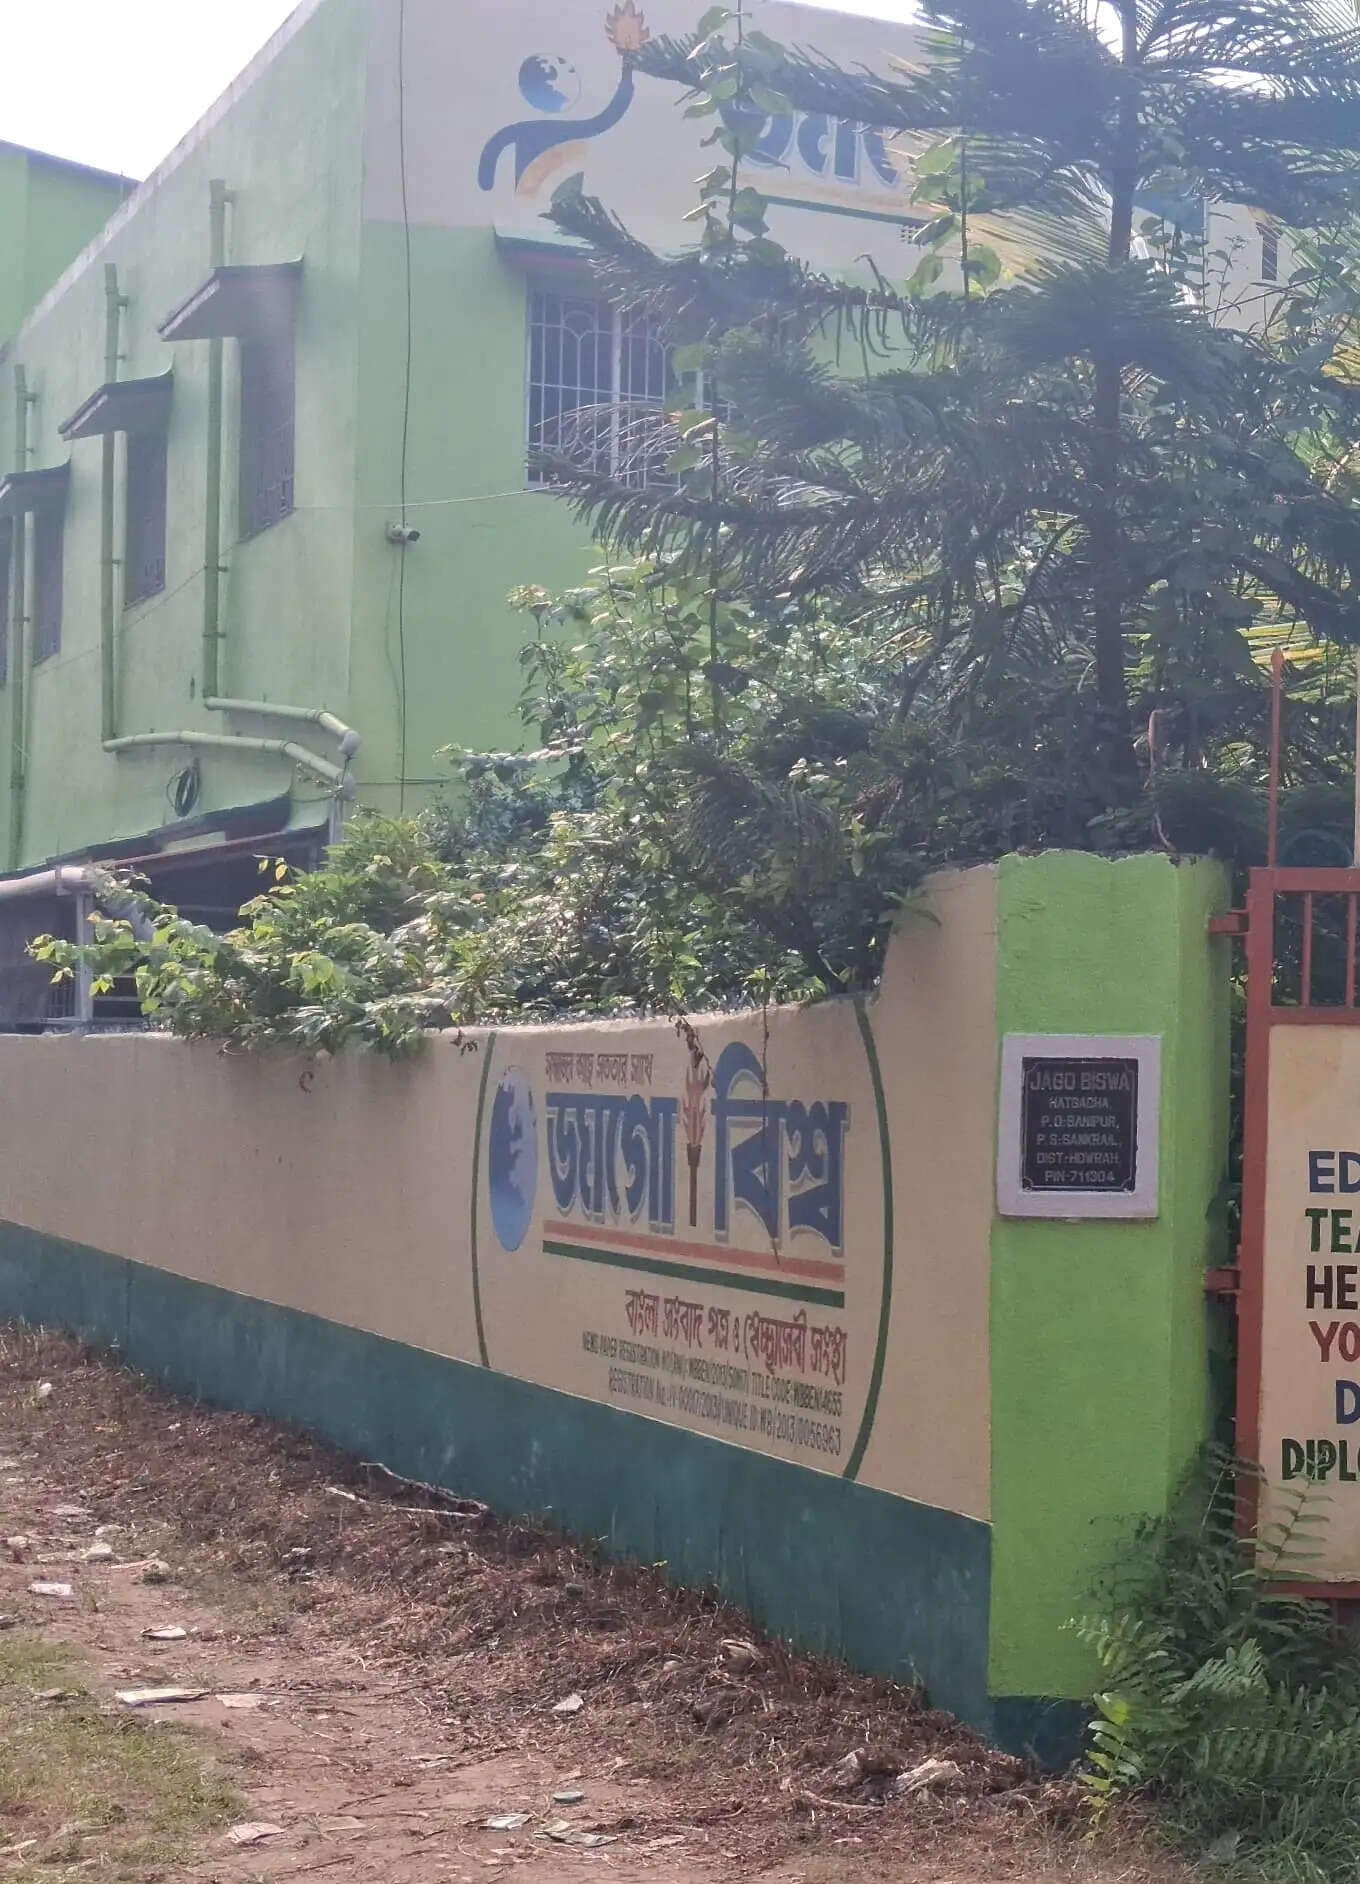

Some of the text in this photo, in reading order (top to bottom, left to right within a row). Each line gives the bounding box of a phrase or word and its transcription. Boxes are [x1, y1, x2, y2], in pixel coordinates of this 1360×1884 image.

[1030, 1071, 1130, 1091] JAGO BISWA
[545, 1040, 850, 1258] জাগো বিশ্ব
[624, 1288, 661, 1337] বাংলা
[663, 1296, 705, 1349] সংবাদ
[707, 1306, 730, 1350] পত্র
[733, 1316, 740, 1353] ও
[810, 1325, 848, 1386] সংস্থা
